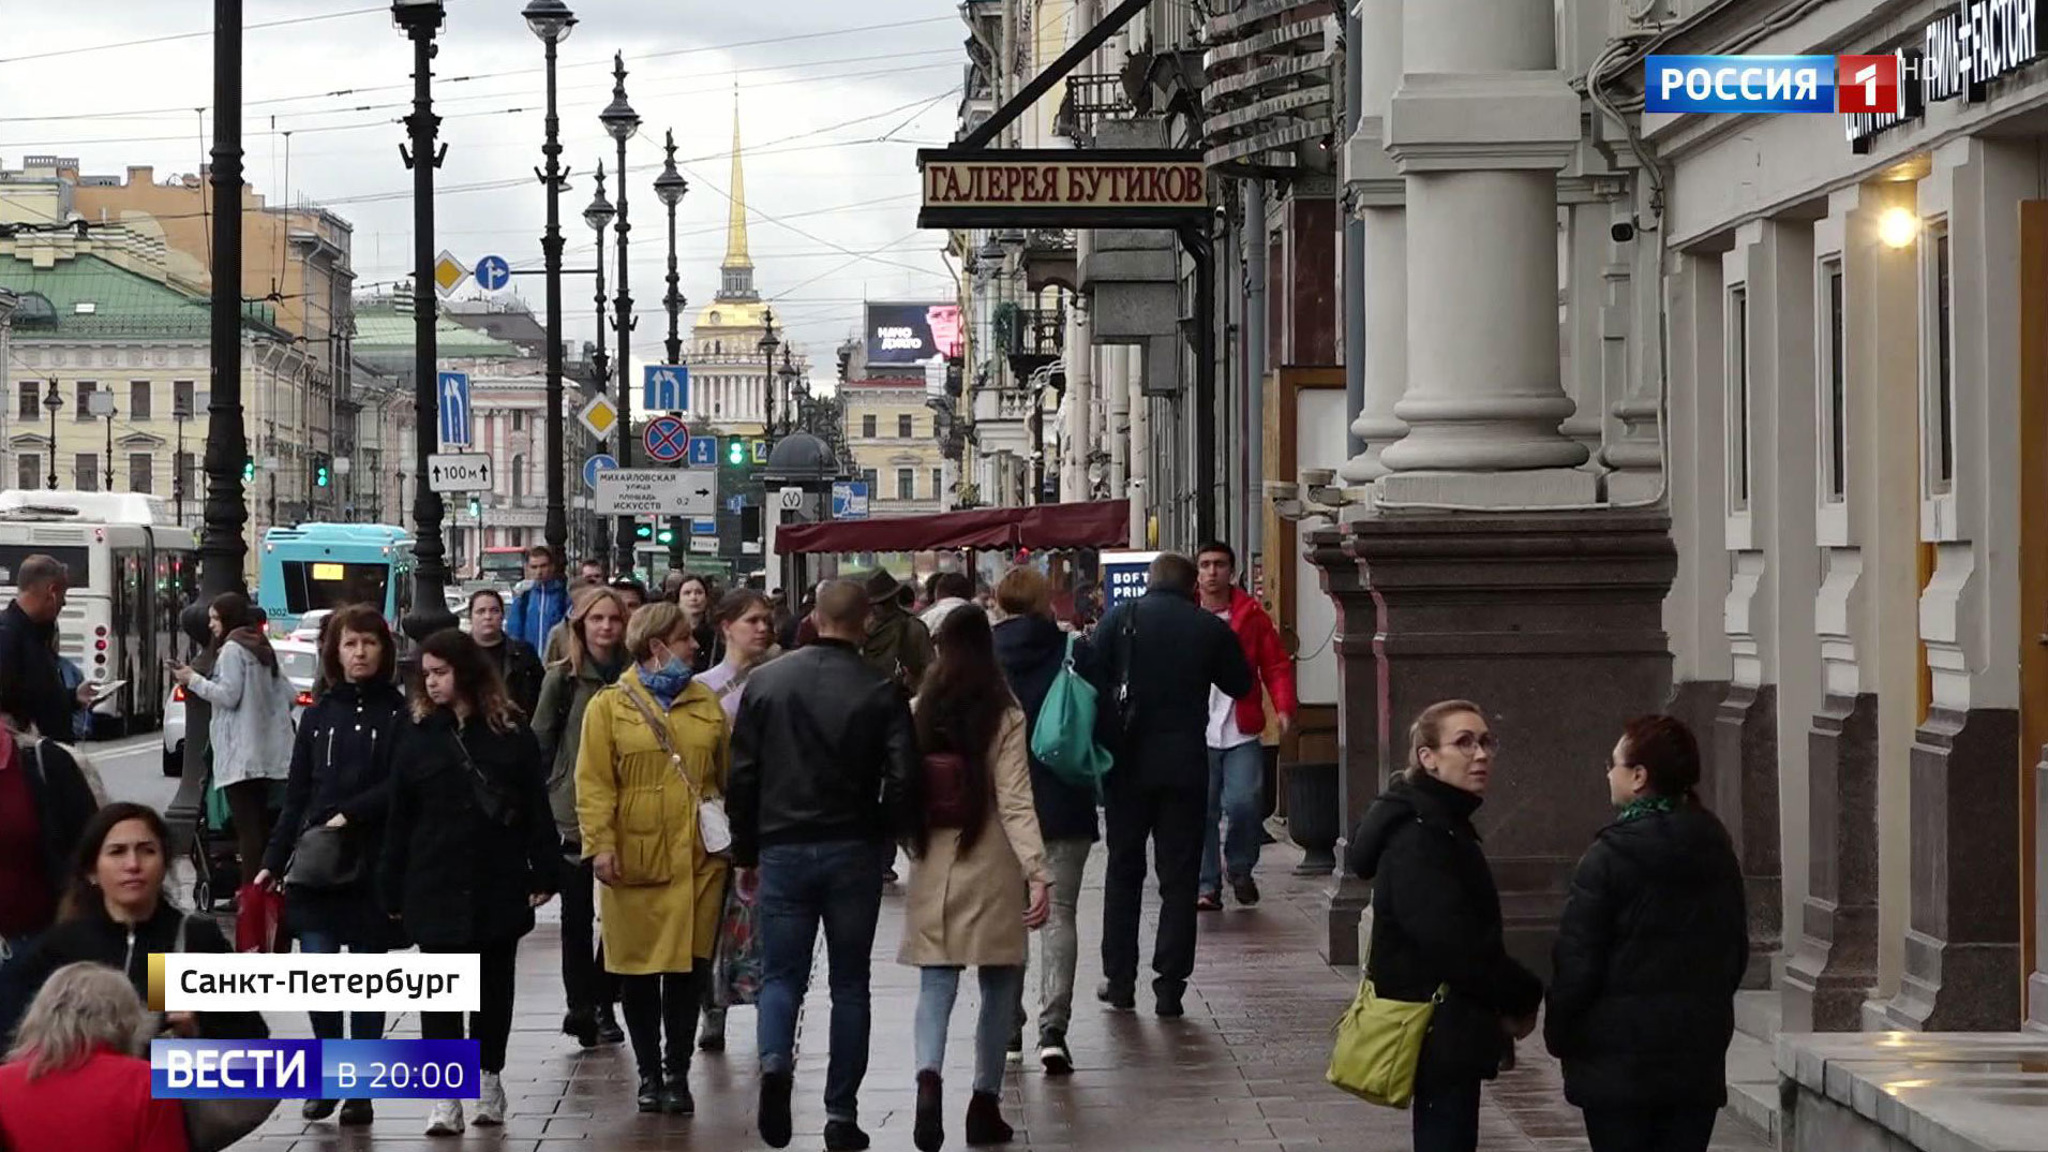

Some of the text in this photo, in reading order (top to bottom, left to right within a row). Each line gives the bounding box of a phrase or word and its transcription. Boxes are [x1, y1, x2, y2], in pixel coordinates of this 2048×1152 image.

[1971, 0, 2036, 84] FACTORY
[929, 166, 1203, 203] ГАЛЕРЕЯ БУТИКОВ
[600, 473, 676, 482] МИХАЙЛОВСКАЯ
[613, 502, 661, 510] ИСКУССТВ
